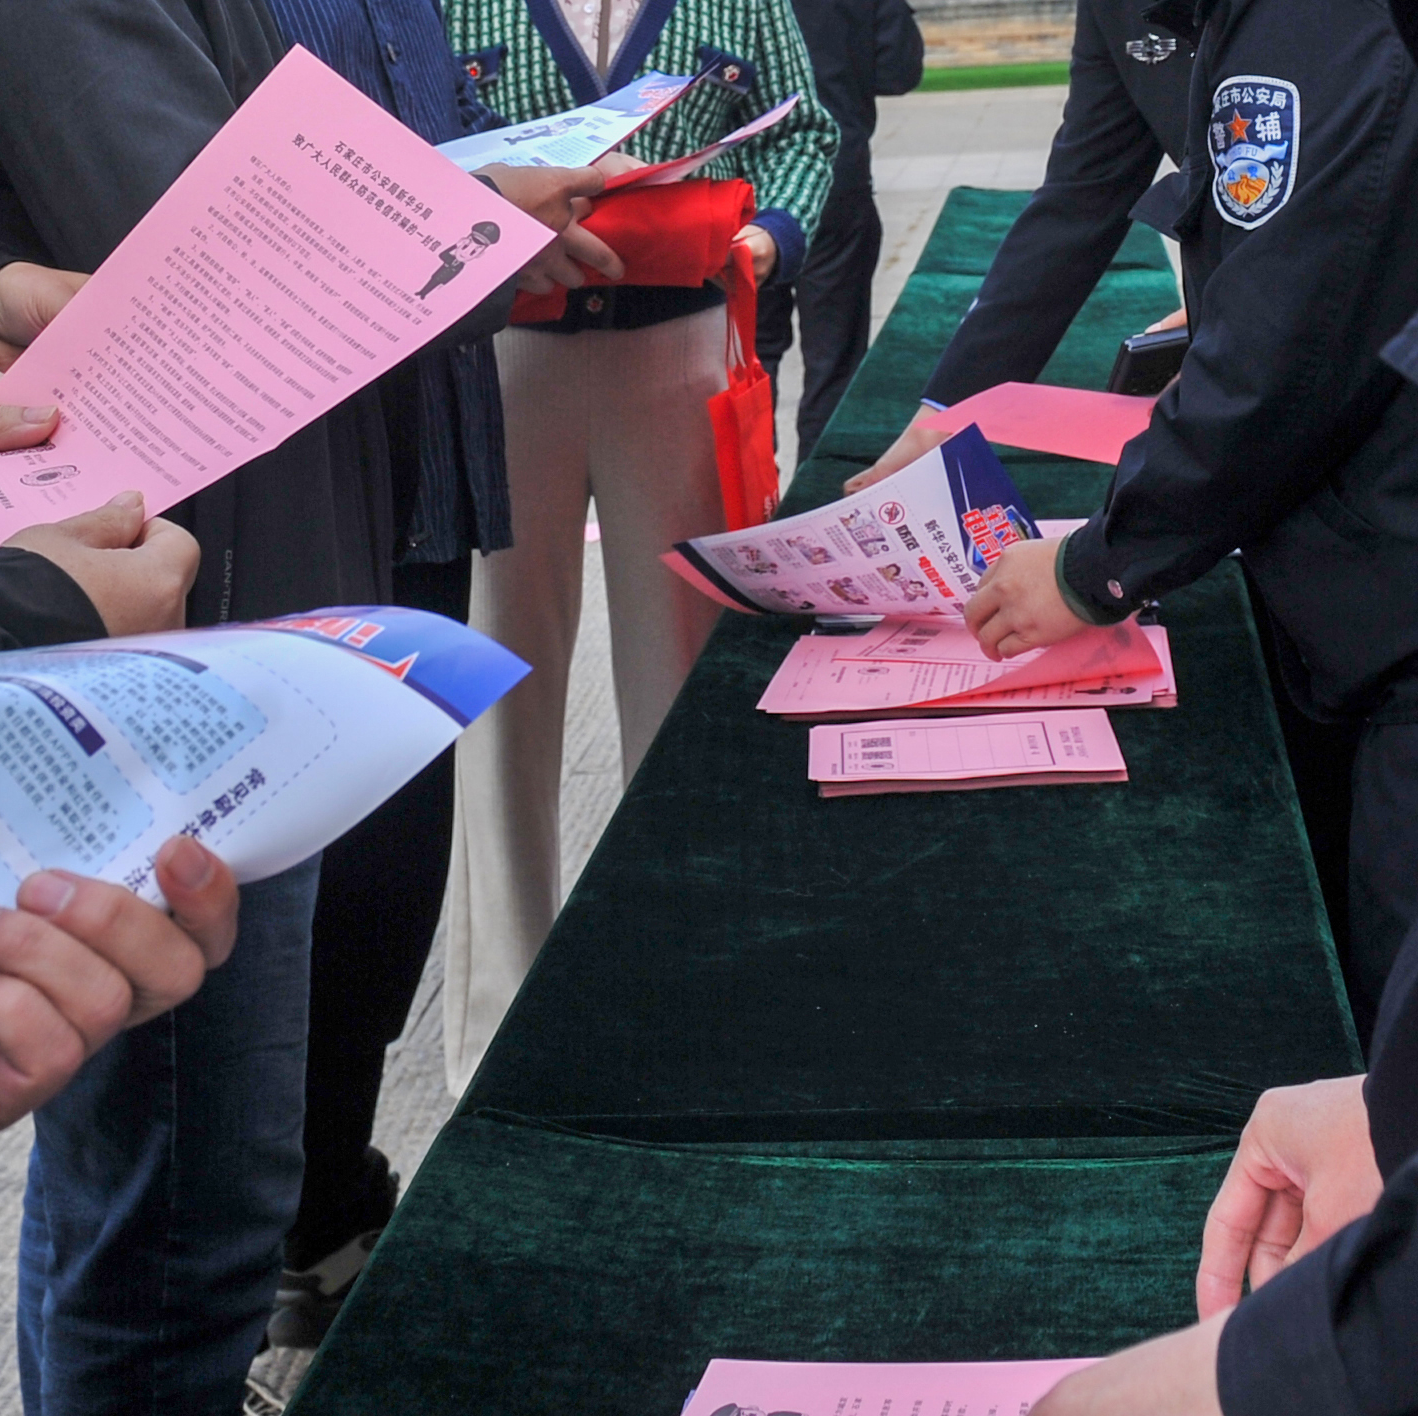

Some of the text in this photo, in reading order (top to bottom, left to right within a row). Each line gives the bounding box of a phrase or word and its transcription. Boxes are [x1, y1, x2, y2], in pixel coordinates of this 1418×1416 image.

[1254, 110, 1282, 142] 辅
[290, 133, 442, 254] 致广大人民群众防范电信诈骗的一封信
[331, 140, 433, 222] 石家庄市公安局新华分局
[924, 519, 980, 597] 新华公安分局提
